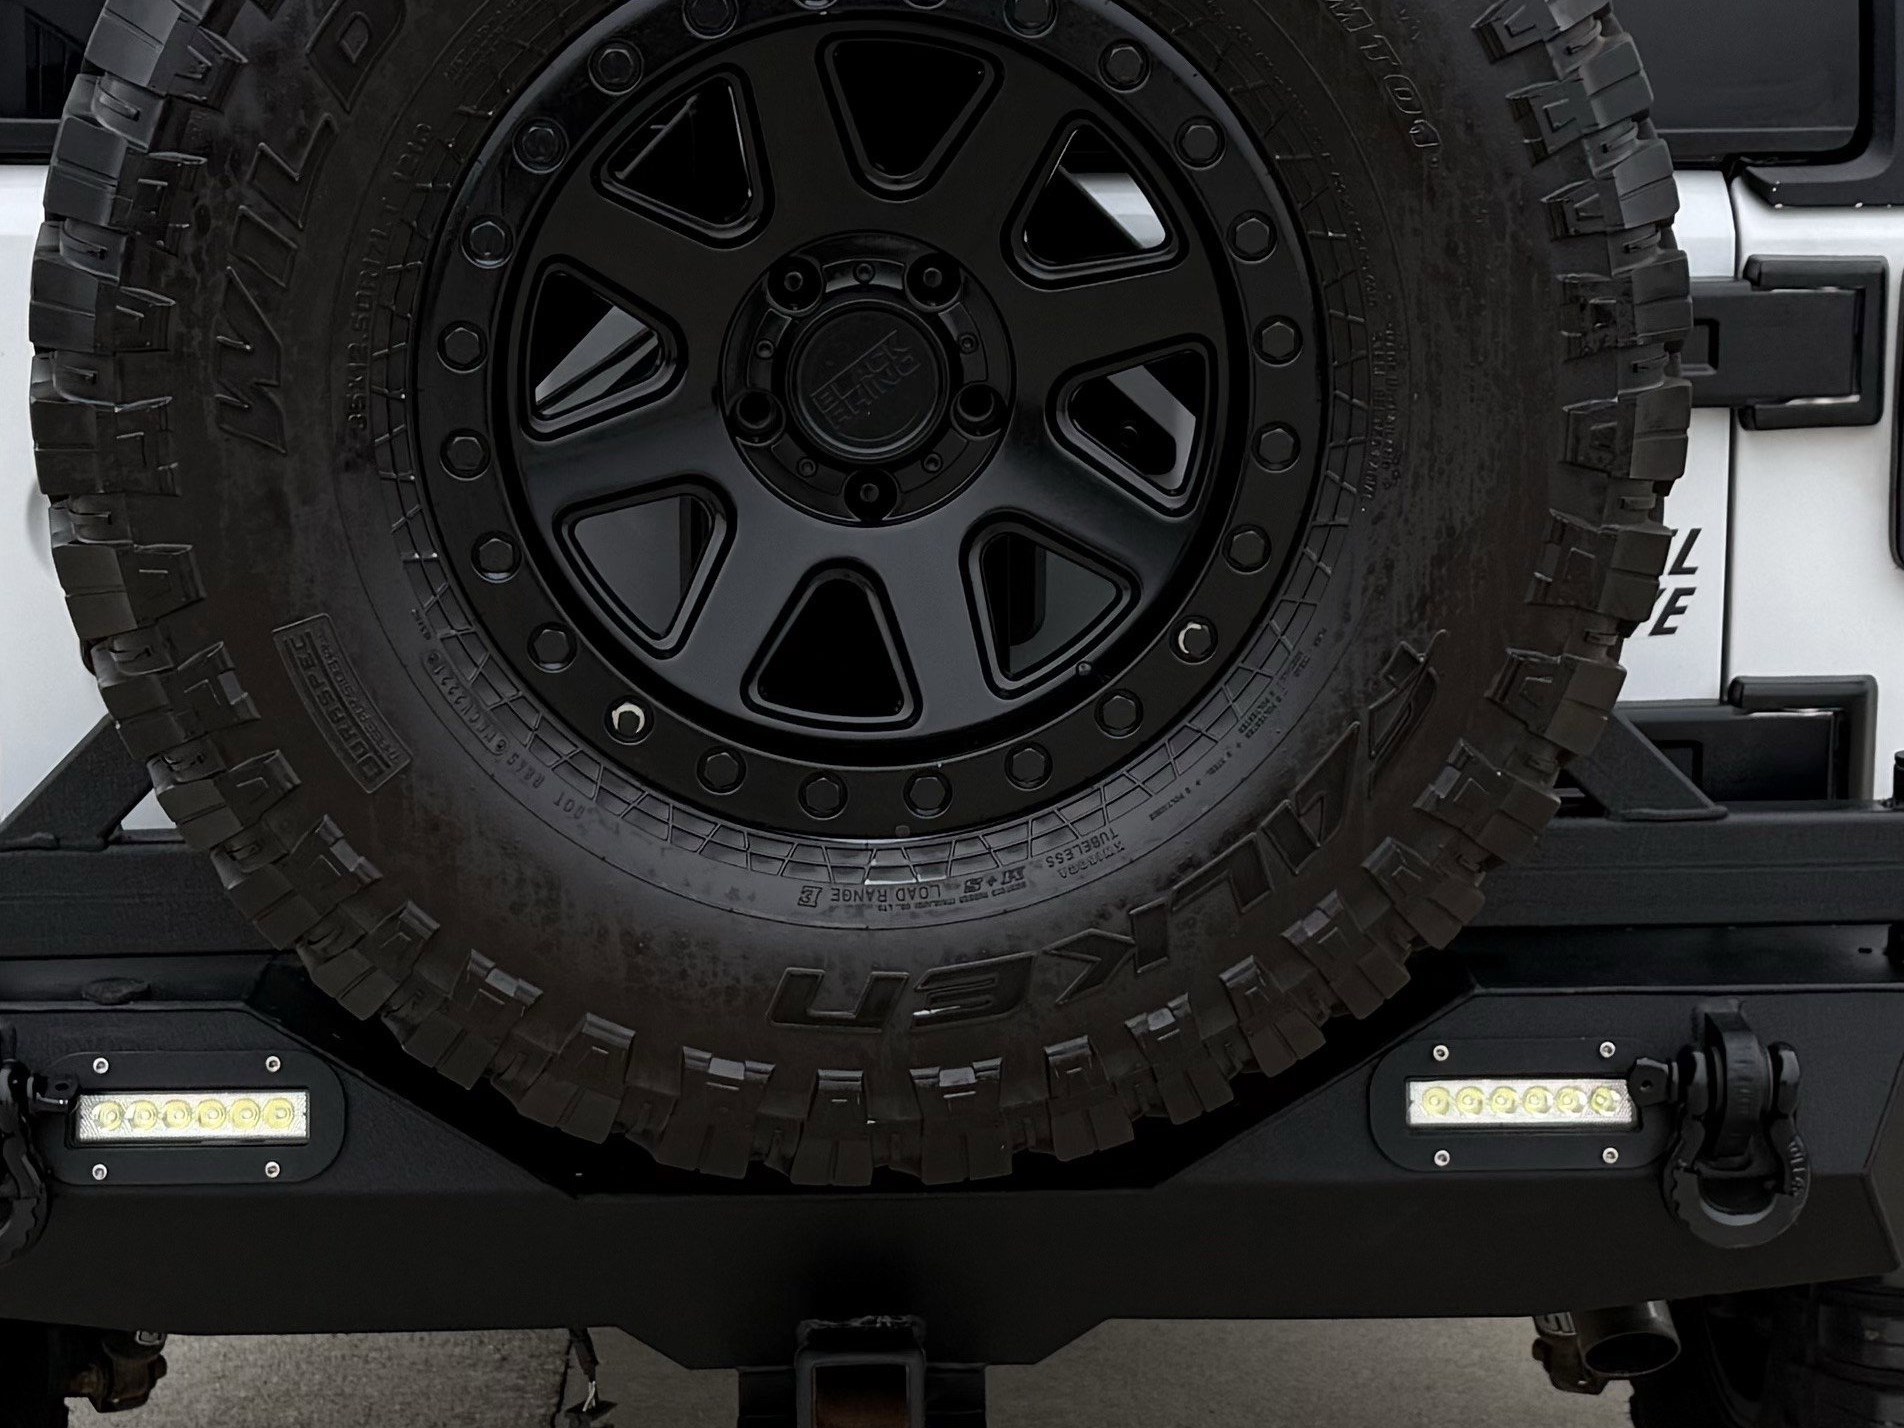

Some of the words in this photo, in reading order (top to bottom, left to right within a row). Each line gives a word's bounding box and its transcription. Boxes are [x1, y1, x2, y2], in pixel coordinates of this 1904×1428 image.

[1044, 825, 1120, 869] TUBELESS
[828, 885, 887, 904] RANGE
[893, 882, 943, 903] LOAD
